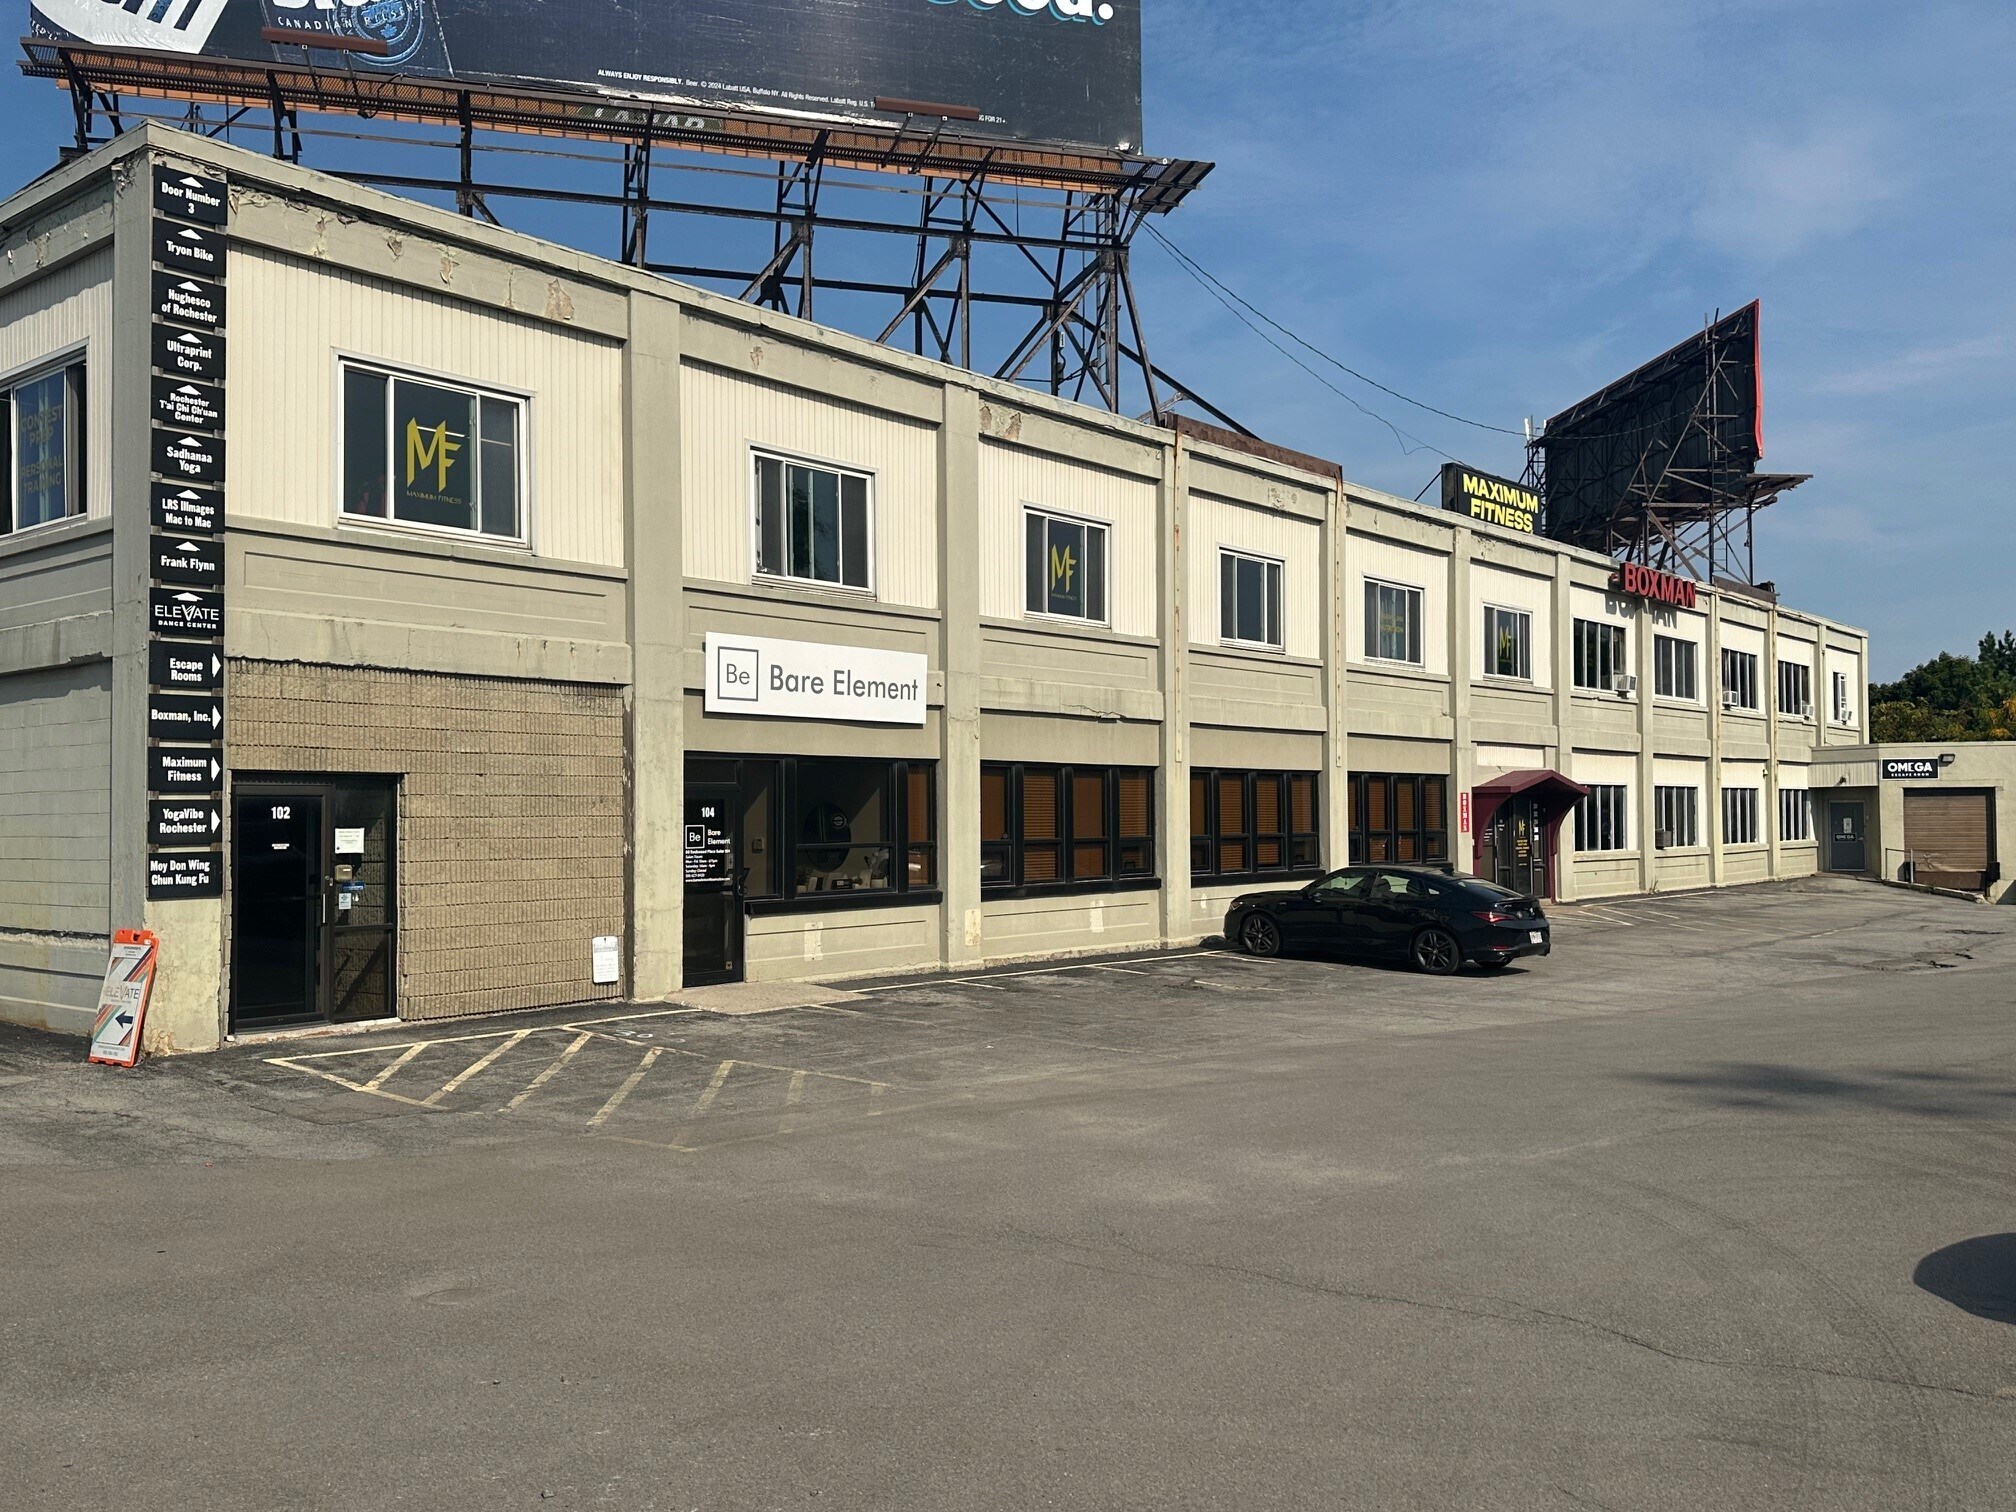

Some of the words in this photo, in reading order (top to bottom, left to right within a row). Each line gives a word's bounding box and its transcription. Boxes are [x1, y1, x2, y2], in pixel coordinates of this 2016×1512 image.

[278, 16, 352, 30] CANADIAN
[598, 69, 622, 78] ALWAYS
[623, 72, 642, 81] ENJOY
[642, 74, 684, 85] RESPONSIBLY.
[686, 79, 700, 87] Beer.
[708, 82, 722, 90] 2024
[722, 83, 739, 92] Labatt
[752, 86, 771, 96] Buffalo
[788, 92, 804, 100] Rights
[161, 181, 184, 198] Door
[185, 188, 220, 207] Number
[188, 202, 195, 214] 3
[166, 240, 192, 257] Tryon
[194, 246, 214, 262] Bike
[168, 288, 212, 308] Hughesco
[161, 303, 172, 313] of
[172, 304, 218, 324] Rochester
[166, 340, 212, 360] Ultraprint
[177, 356, 202, 372] Corp.
[170, 392, 210, 408] Rochester
[176, 402, 190, 413] Chi
[174, 412, 204, 424] Center
[166, 446, 213, 464] Sadhanaa
[406, 417, 462, 493] MF
[179, 460, 202, 474] Yoga
[1462, 473, 1538, 514] MAXIMUM
[162, 498, 179, 512] LRS
[165, 512, 183, 526] Mac
[184, 514, 192, 526] to
[194, 516, 212, 528] Mac
[1470, 497, 1534, 533] FITNESS
[160, 555, 188, 569] Frank
[190, 558, 216, 572] Flynn
[1051, 544, 1077, 594] MF
[1623, 561, 1696, 609] BOXMAN
[154, 604, 220, 622] ELEVATE
[186, 622, 217, 630] CENTER
[170, 657, 204, 672] Escape
[170, 669, 202, 682] Rooms
[726, 663, 750, 685] Be
[770, 664, 824, 695] Bare
[833, 669, 918, 701] Element
[151, 709, 192, 724] Boxman,
[193, 710, 211, 722] Inc.
[162, 756, 207, 768] Maximum
[1887, 762, 1933, 772] OMEGA
[168, 770, 202, 782] Fitness
[162, 808, 204, 822] YogaVibe
[271, 806, 290, 820] 102
[701, 806, 716, 818] 104
[160, 822, 207, 834] Rochester
[689, 832, 701, 842] Be
[150, 860, 168, 874] Moy
[169, 860, 186, 872] Don
[188, 859, 210, 872] Wing
[151, 874, 174, 886] Chun
[175, 874, 198, 887] Kung
[198, 872, 210, 885] Fu
